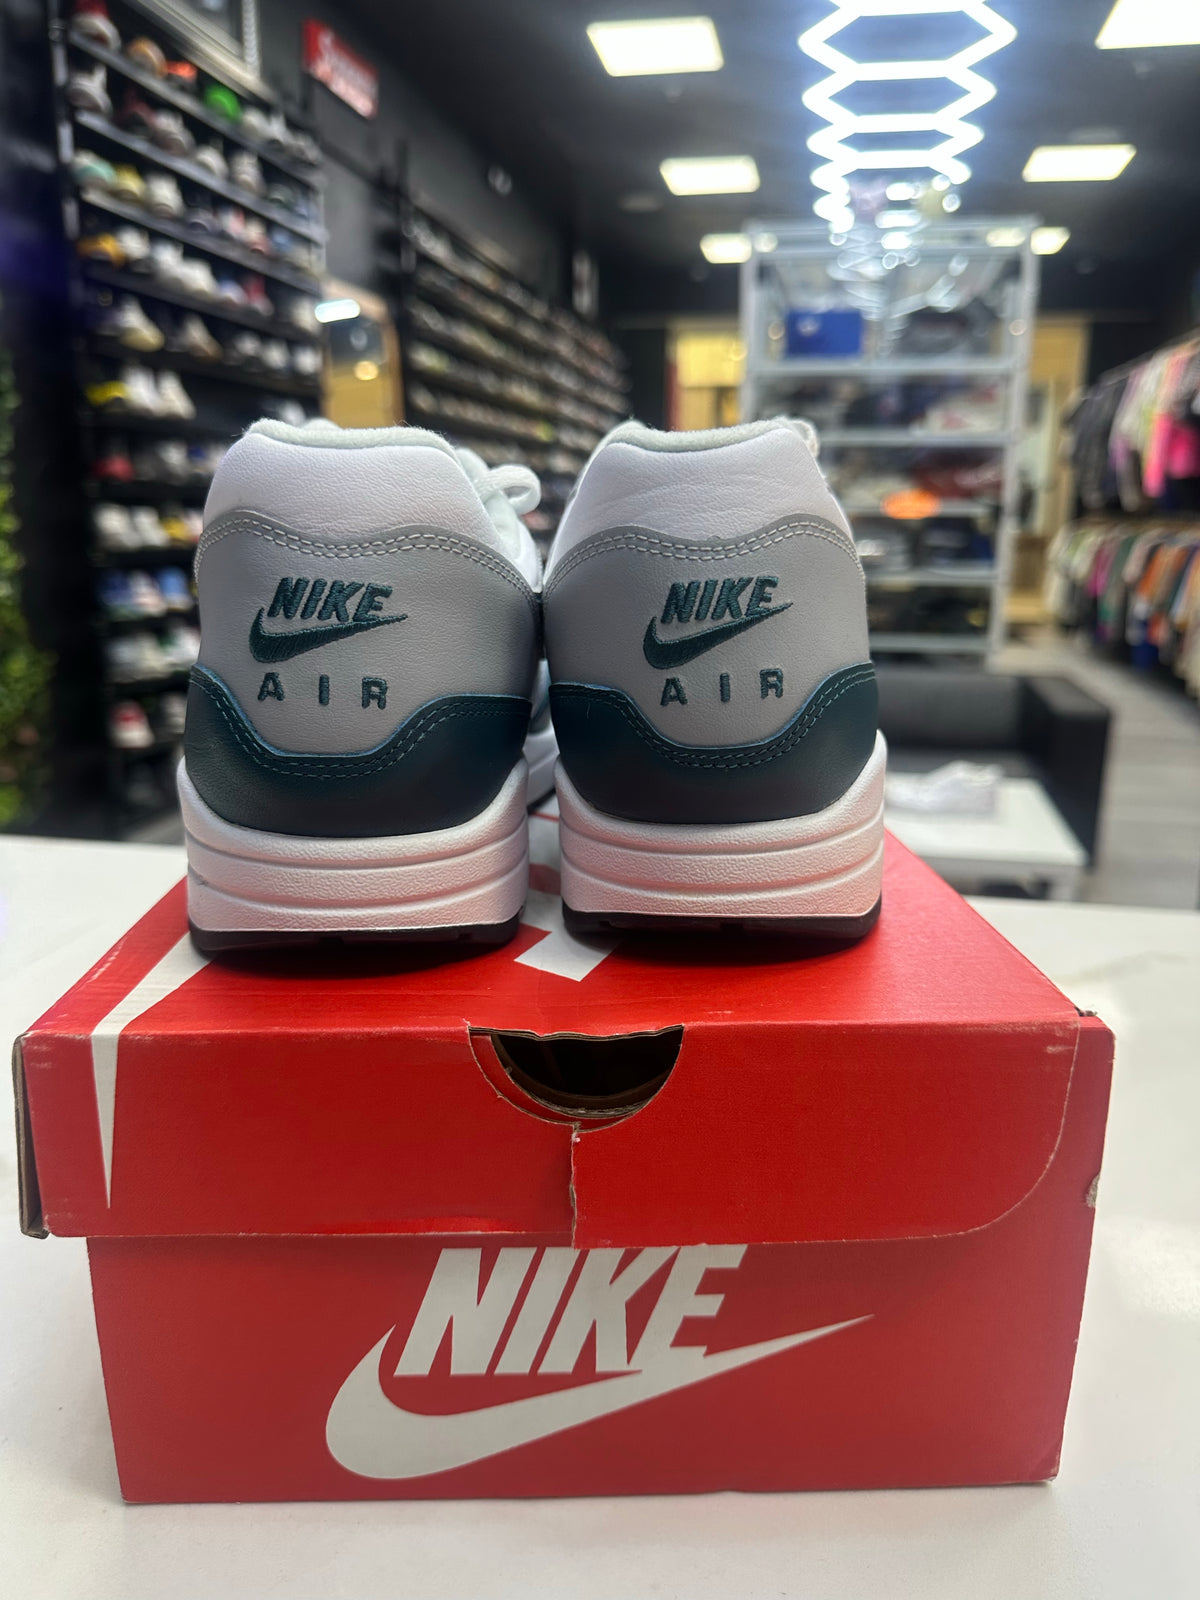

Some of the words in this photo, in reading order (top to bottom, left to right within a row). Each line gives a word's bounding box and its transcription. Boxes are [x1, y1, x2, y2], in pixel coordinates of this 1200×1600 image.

[267, 577, 393, 622] NIKE
[660, 575, 779, 624] NIKE
[257, 672, 388, 710] AIR
[660, 668, 784, 706] AIR
[394, 1244, 748, 1377] NIKE
